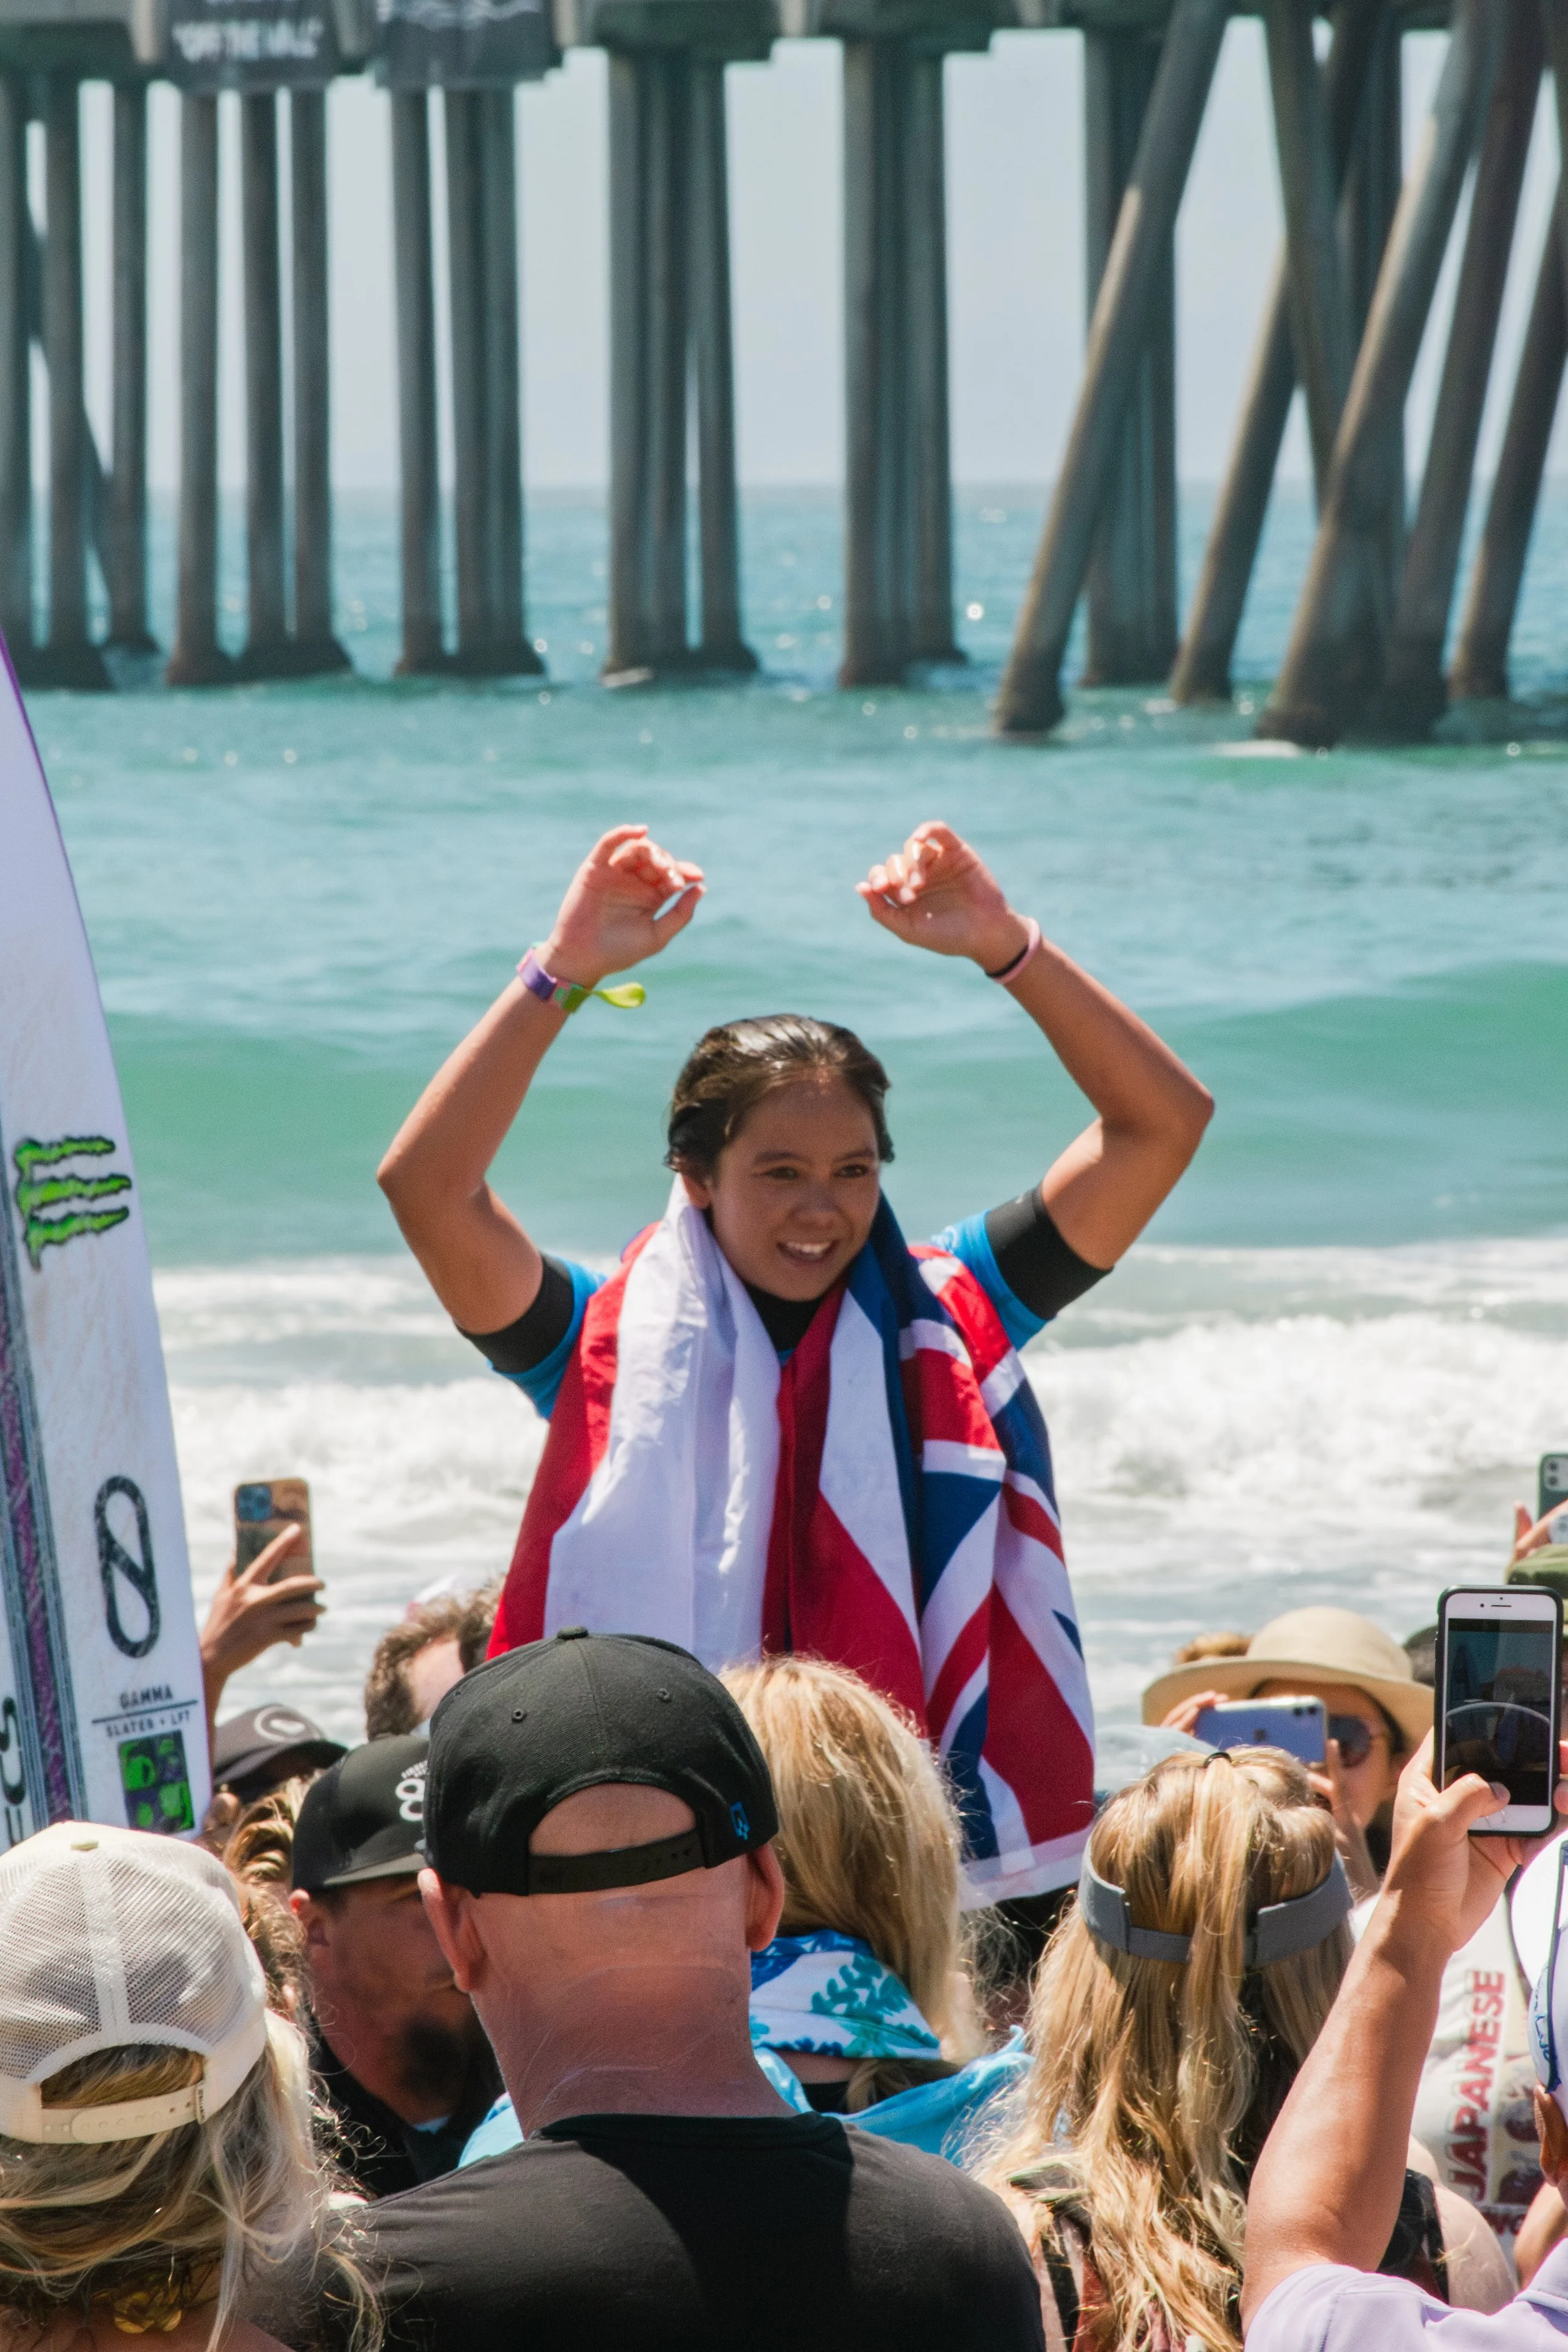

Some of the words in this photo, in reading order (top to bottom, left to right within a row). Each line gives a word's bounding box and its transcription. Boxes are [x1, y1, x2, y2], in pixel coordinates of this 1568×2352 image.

[120, 1684, 172, 1708] GAMMA
[106, 1718, 154, 1737] SLATER
[1450, 1969, 1505, 2202] JAPANESE
